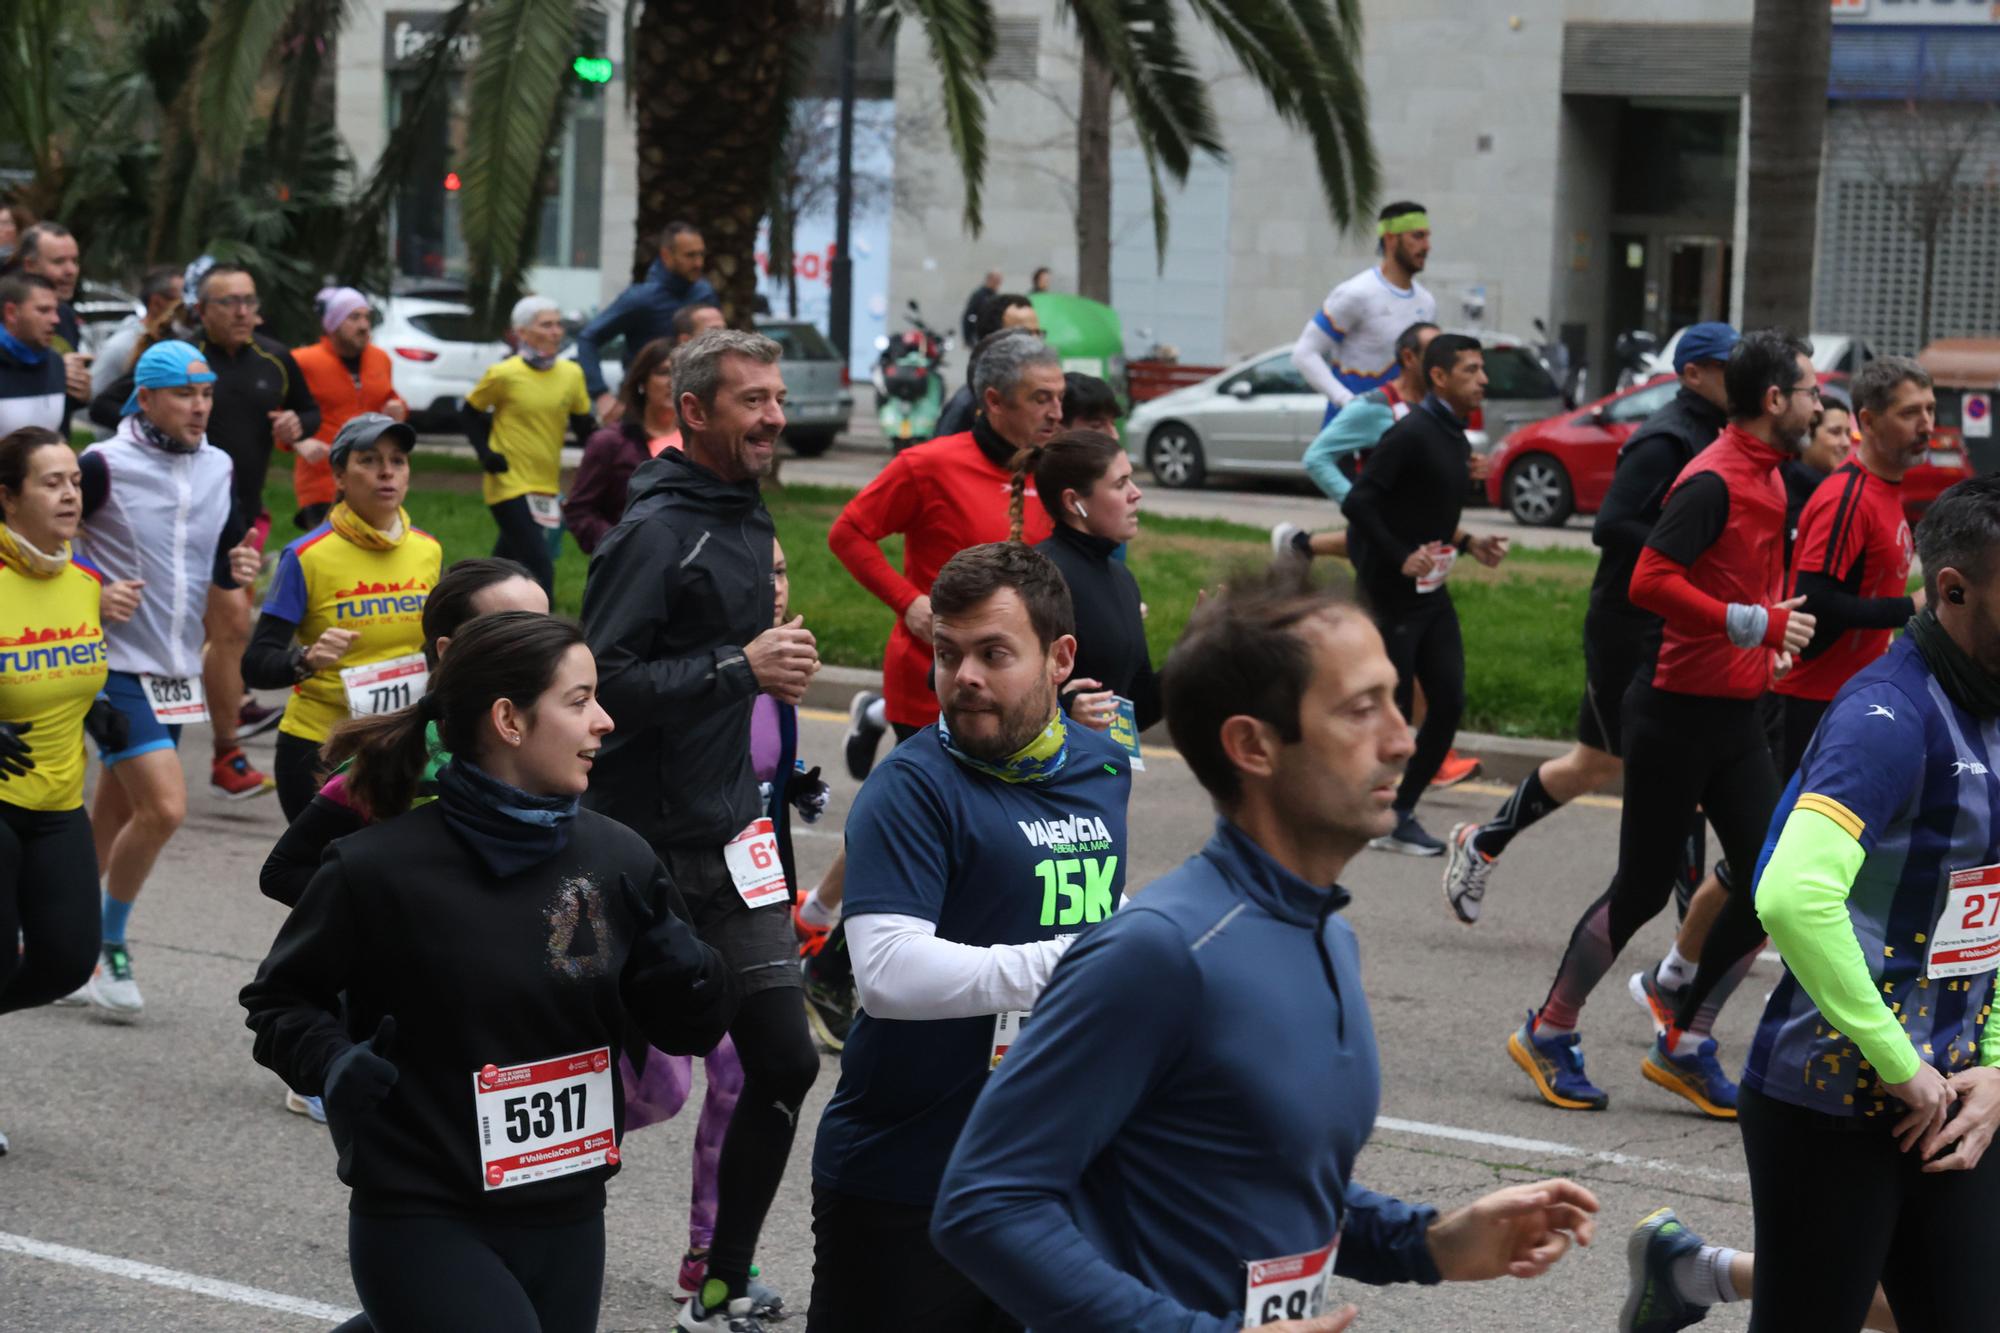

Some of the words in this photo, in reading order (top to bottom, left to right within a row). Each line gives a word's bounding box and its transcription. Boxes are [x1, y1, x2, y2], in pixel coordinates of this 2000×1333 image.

[368, 682, 411, 714] 7711
[1079, 842, 1091, 852] AL
[1090, 839, 1111, 851] MAR
[1035, 855, 1118, 926] 15K
[503, 1083, 588, 1145] 5317
[518, 1145, 581, 1166] #ValènciaCorre
